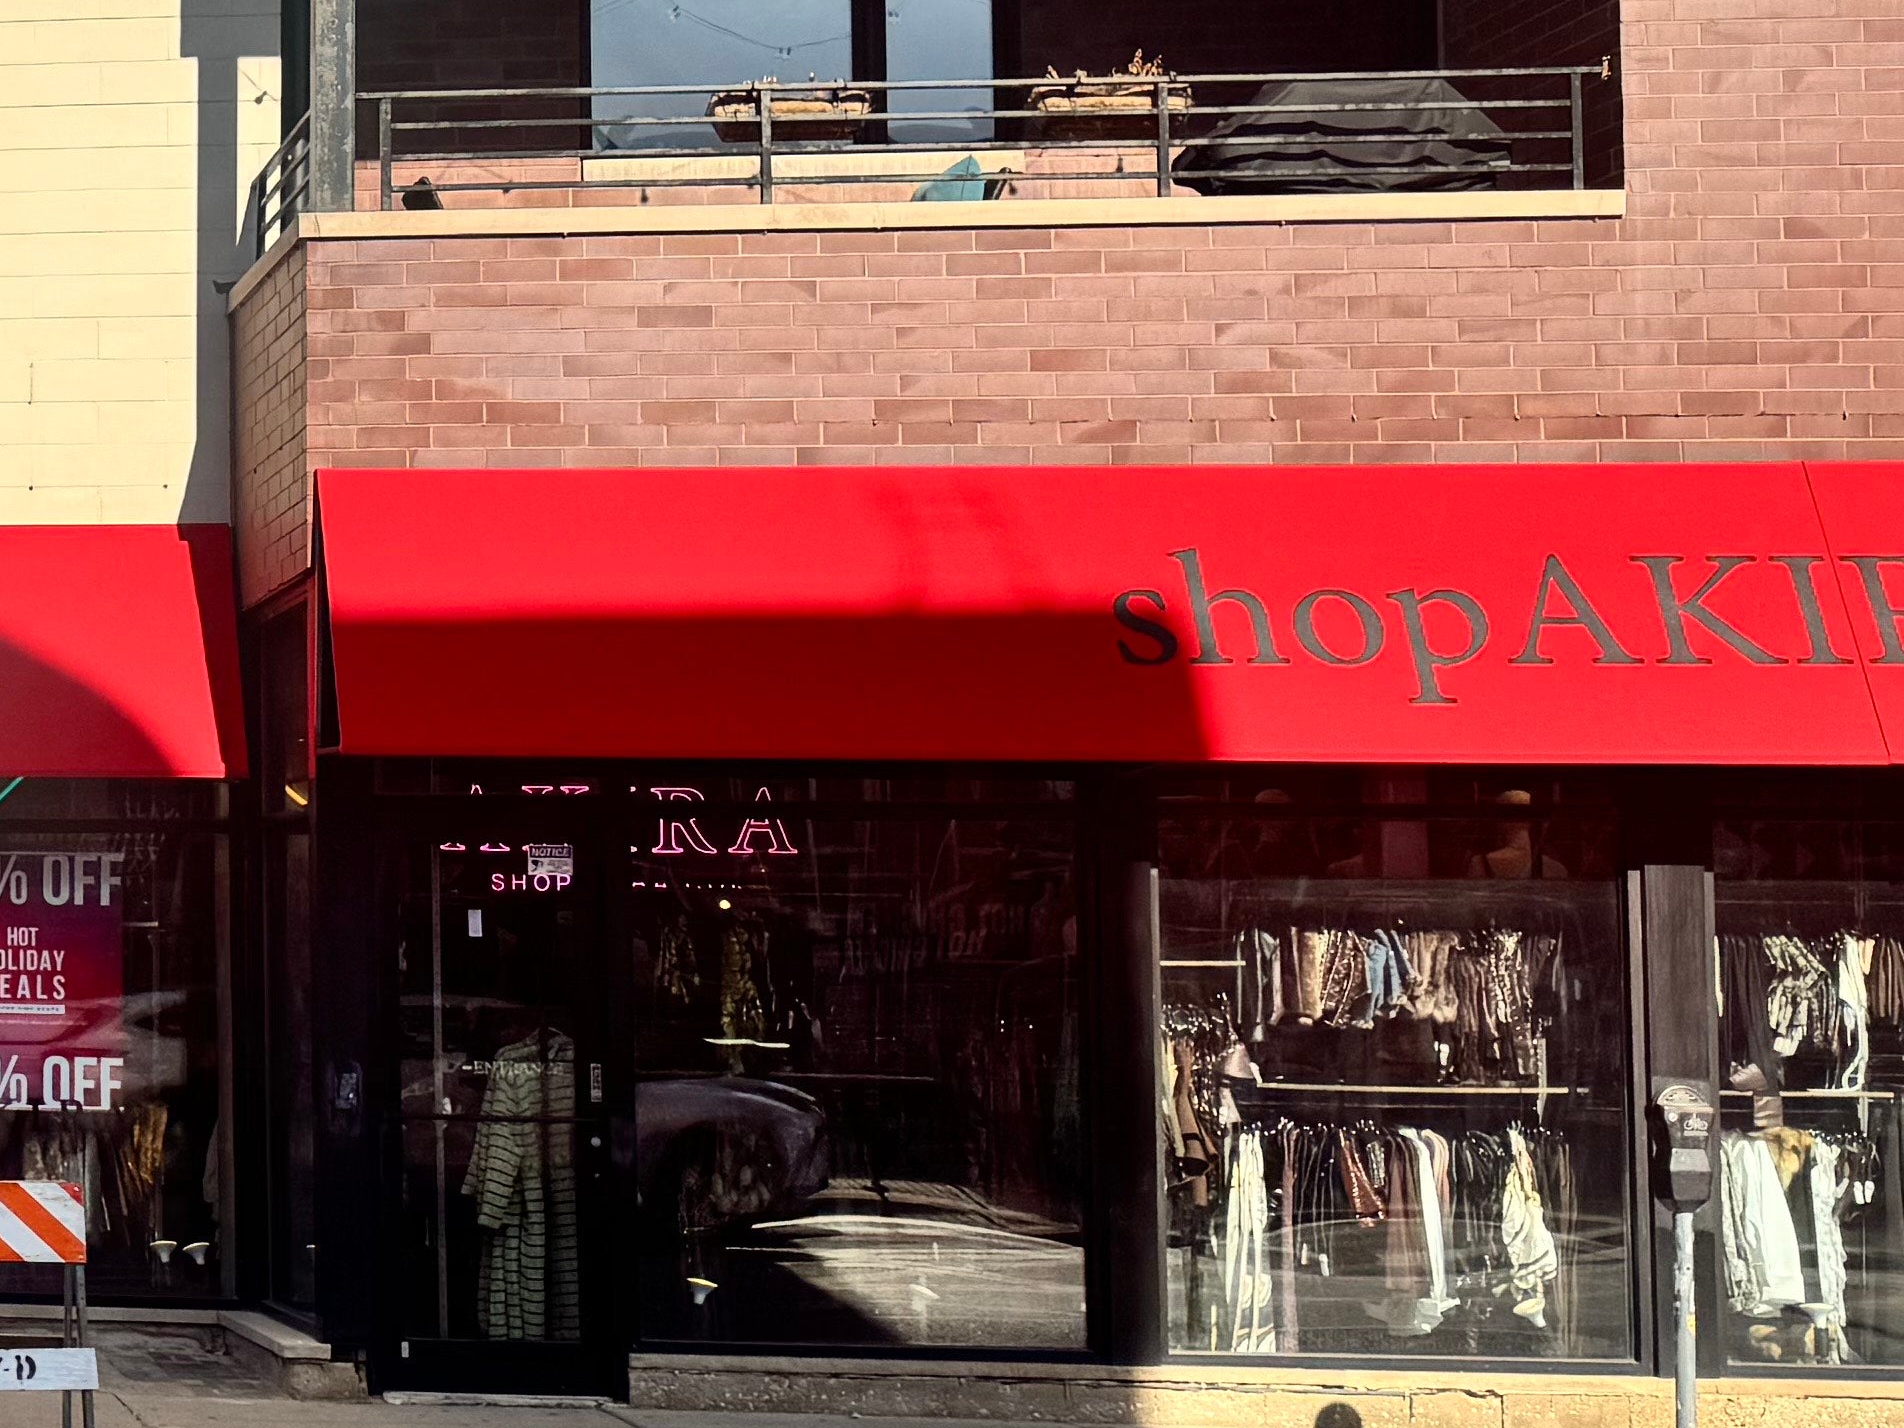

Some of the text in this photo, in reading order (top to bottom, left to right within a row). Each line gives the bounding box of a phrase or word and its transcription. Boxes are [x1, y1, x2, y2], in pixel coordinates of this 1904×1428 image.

[531, 847, 570, 857] NOTICE
[41, 852, 125, 907] OFF
[490, 873, 571, 892] SHOP
[6, 926, 40, 947] HOT
[41, 1055, 125, 1110] OFF
